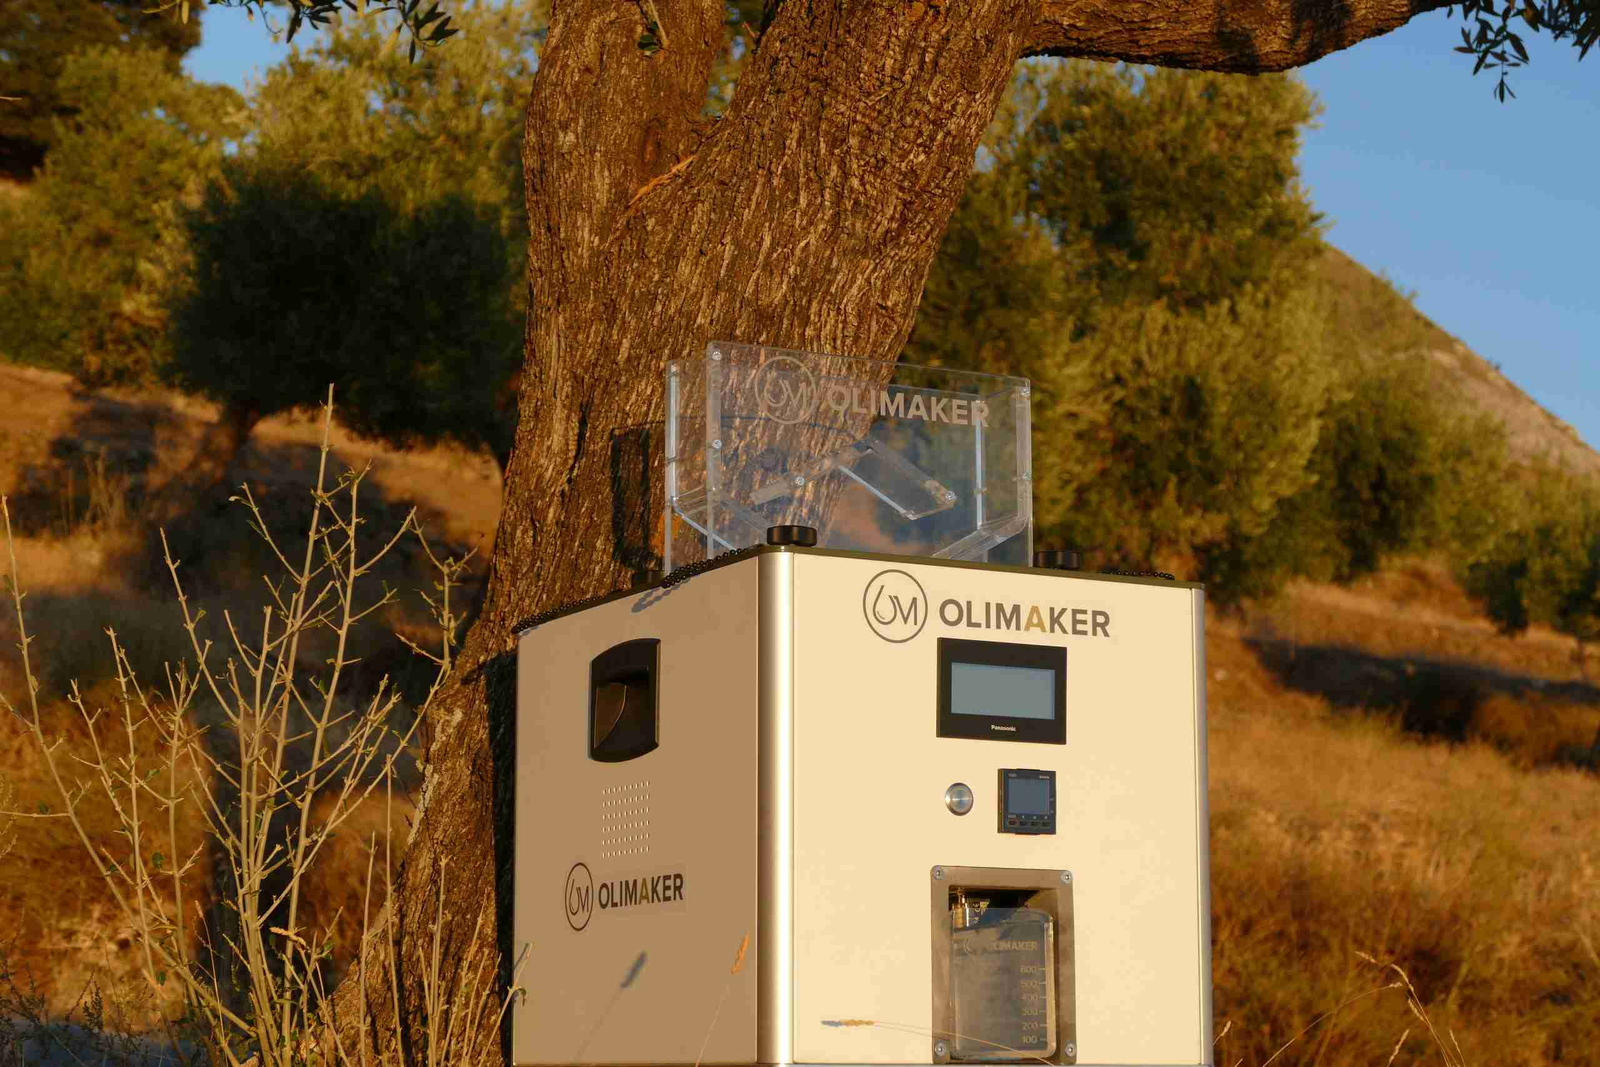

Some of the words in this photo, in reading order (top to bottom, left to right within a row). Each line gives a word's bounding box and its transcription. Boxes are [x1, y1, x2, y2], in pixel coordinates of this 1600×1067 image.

[826, 385, 990, 428] OLIMAKER
[939, 598, 1111, 638] OLIMAKER
[990, 724, 1017, 732] Panasonic
[598, 873, 684, 910] OLIMAKER
[1020, 980, 1037, 988] 500
[1021, 1021, 1038, 1031] 200
